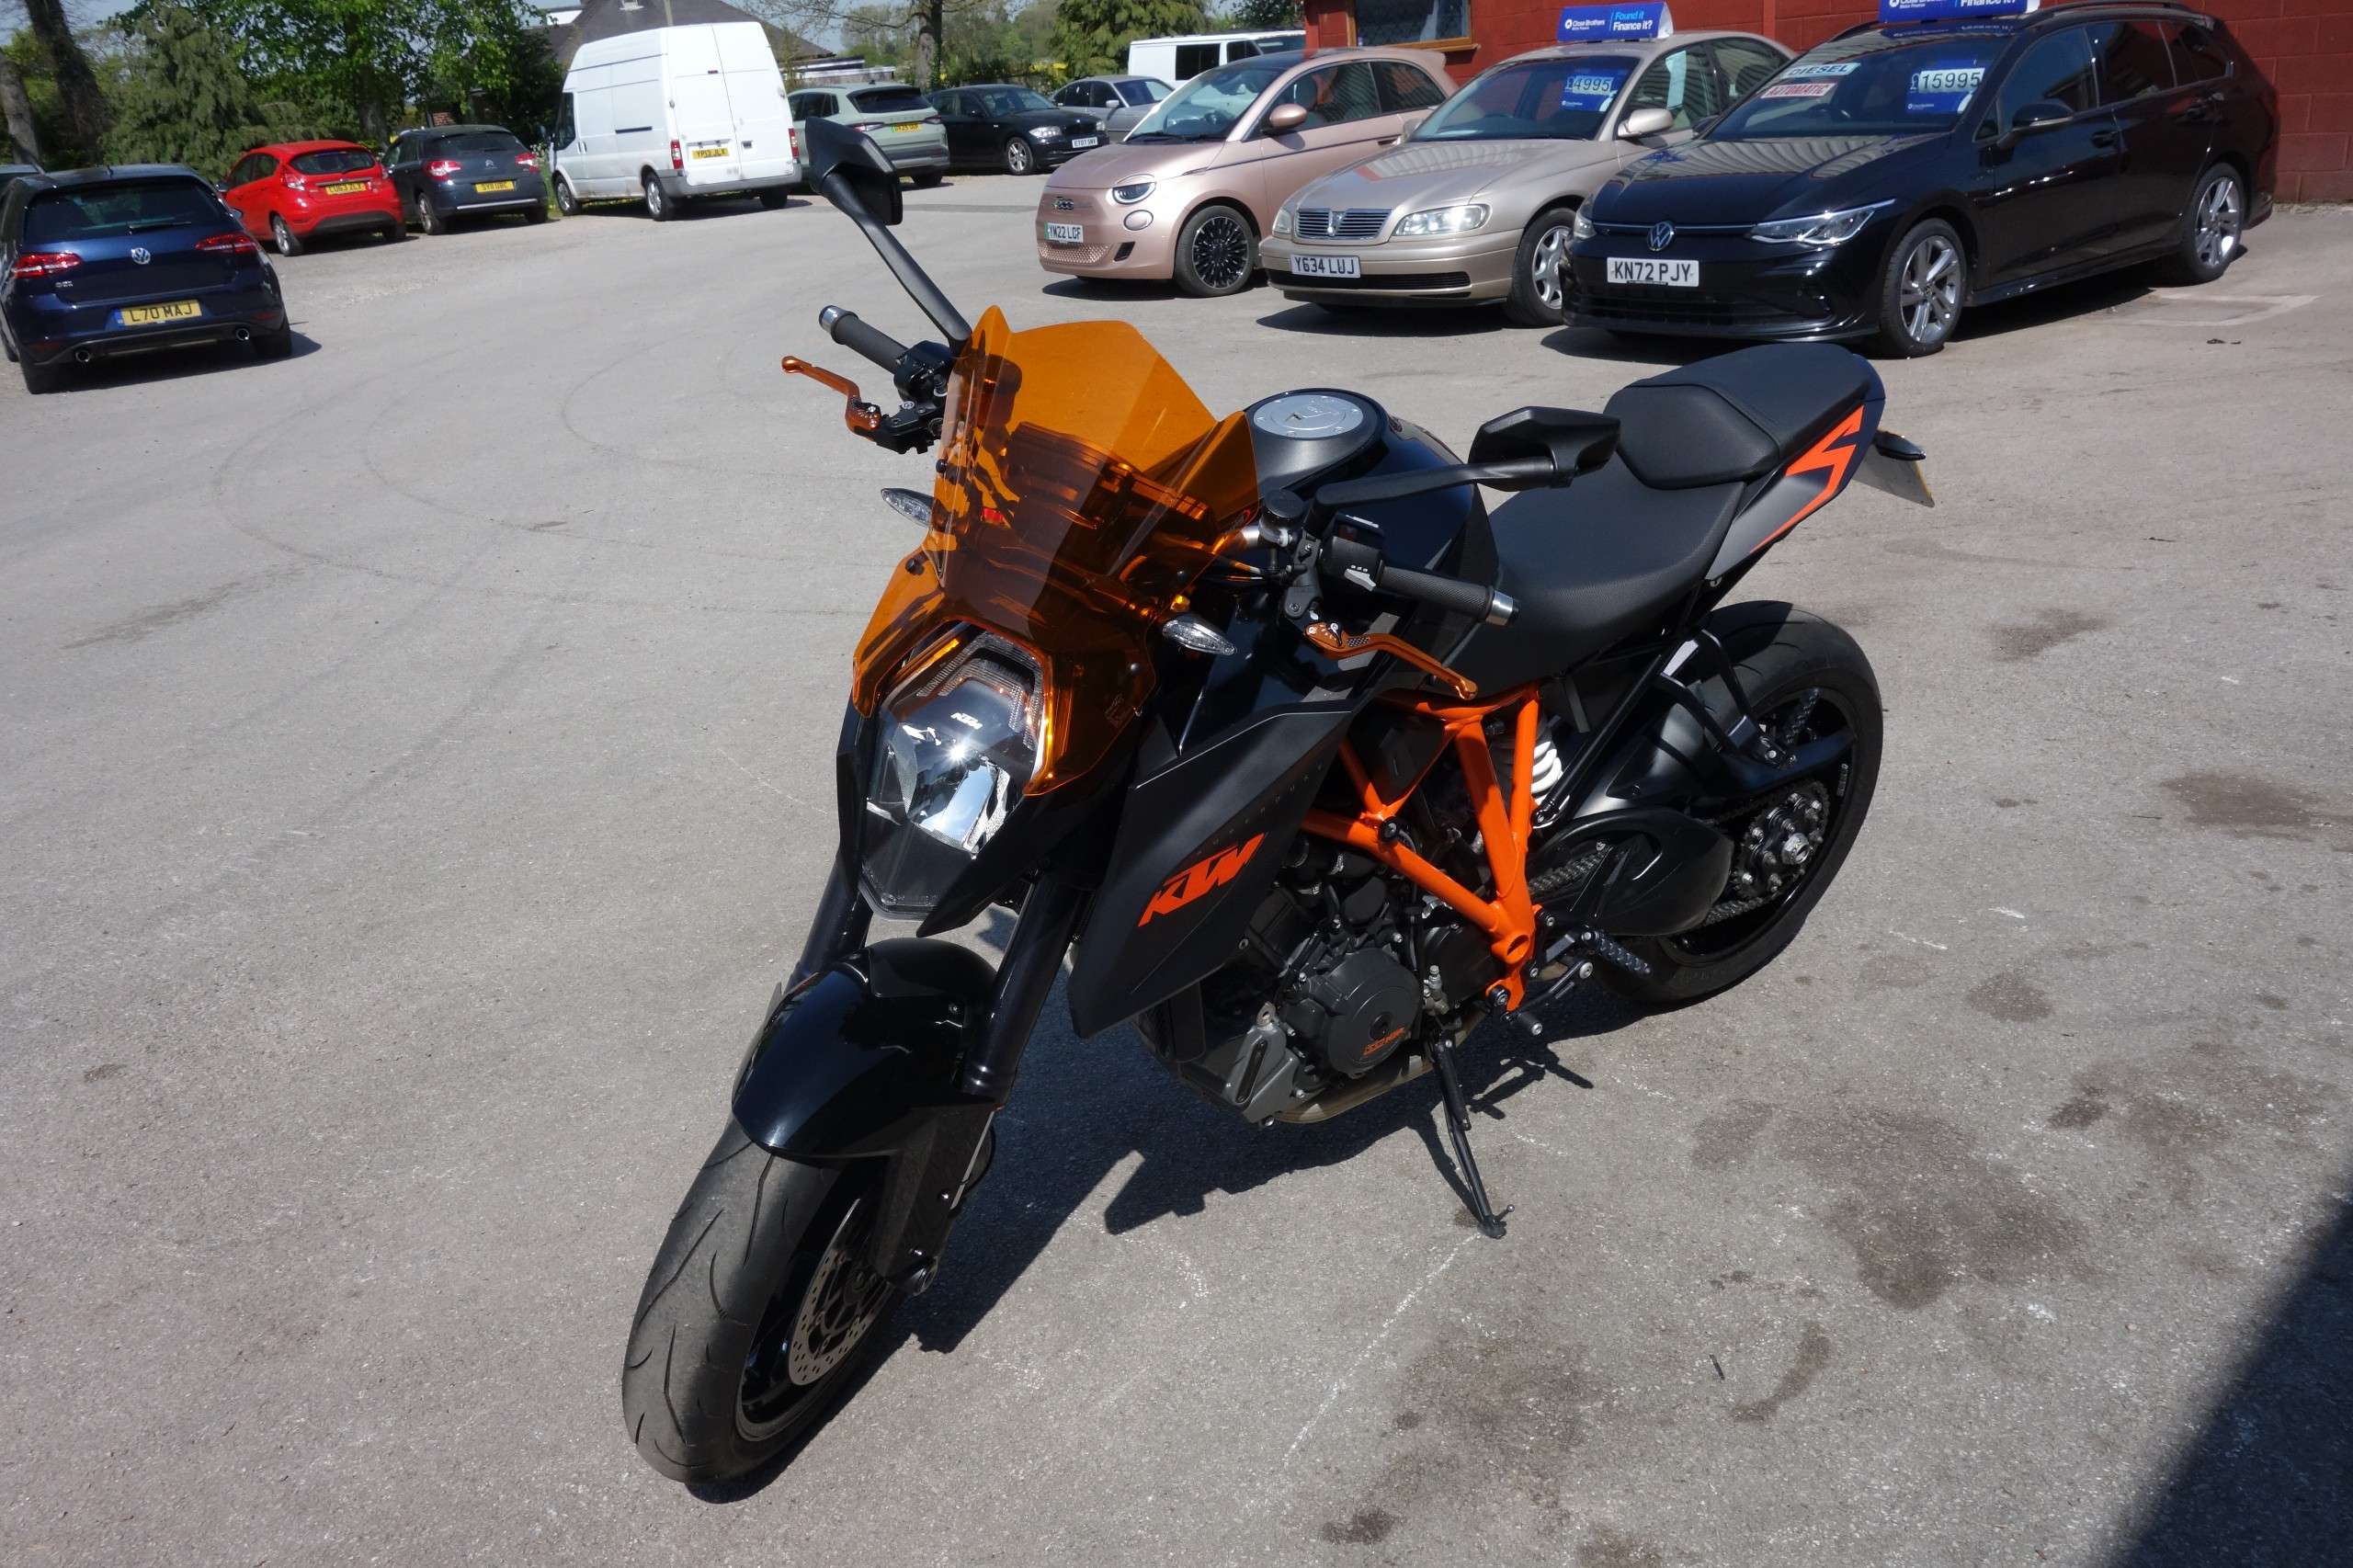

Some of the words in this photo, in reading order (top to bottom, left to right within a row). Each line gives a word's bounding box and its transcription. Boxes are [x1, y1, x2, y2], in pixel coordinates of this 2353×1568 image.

[1615, 11, 1637, 20] Found
[1613, 21, 1642, 30] Finance
[1787, 64, 1848, 75] DIESEL
[1294, 256, 1324, 273] Y634
[1329, 258, 1354, 274] LUJ
[1615, 261, 1654, 280] KN72
[1659, 263, 1690, 281] PJY
[130, 307, 160, 322] L70
[162, 302, 192, 318] MAJ
[950, 712, 983, 730] KTM
[1138, 833, 1265, 927] KTM
